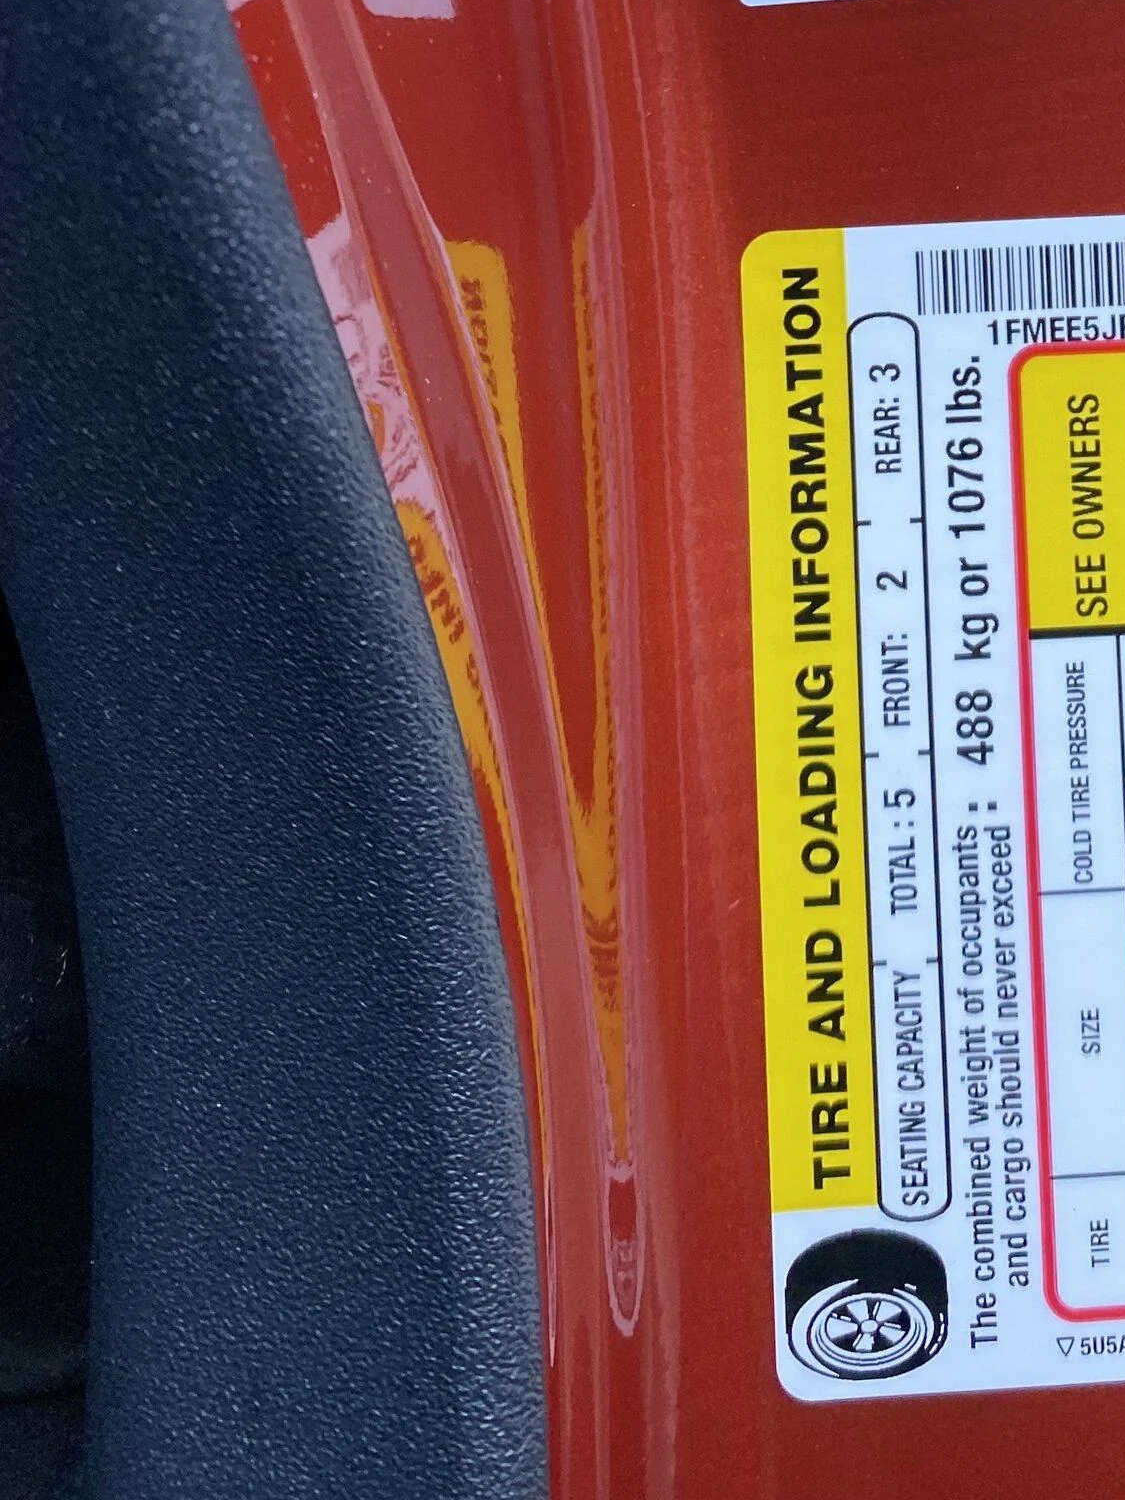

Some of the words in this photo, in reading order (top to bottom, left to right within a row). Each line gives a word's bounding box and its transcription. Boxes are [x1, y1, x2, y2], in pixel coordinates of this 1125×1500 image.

[868, 362, 902, 383] 3
[945, 355, 983, 424] lbs.
[781, 266, 832, 643] INFORMATION
[873, 397, 903, 474] REAR:
[1067, 393, 1106, 540] OWNERS
[945, 436, 986, 539] 1076
[875, 570, 909, 591] 2
[959, 556, 990, 597] or
[1074, 553, 1109, 618] SEE
[954, 612, 1000, 661] kg
[880, 633, 911, 727] FRONT:
[1065, 661, 1089, 770] PRESSURE
[954, 688, 995, 766] 488
[794, 664, 841, 908] LOADING
[883, 788, 917, 809] 5
[1070, 775, 1091, 823] TIRE
[887, 835, 918, 916] TOTAL
[984, 825, 1015, 928] exceed
[1072, 829, 1094, 884] COLD
[951, 825, 988, 977] occupants
[805, 929, 846, 1042] AND
[957, 987, 985, 1015] of
[994, 937, 1019, 1019] never
[893, 970, 926, 1092] CAPACITY
[1080, 1007, 1101, 1055] SIZE
[959, 1025, 994, 1125] weight
[991, 1029, 1024, 1128] should
[809, 1061, 851, 1190] TIRE
[898, 1101, 931, 1207] SEATING
[962, 1136, 996, 1282] combined
[1003, 1137, 1032, 1222] cargo
[1000, 1232, 1030, 1287] and
[1090, 1218, 1110, 1268] TIRE
[970, 1292, 999, 1349] The
